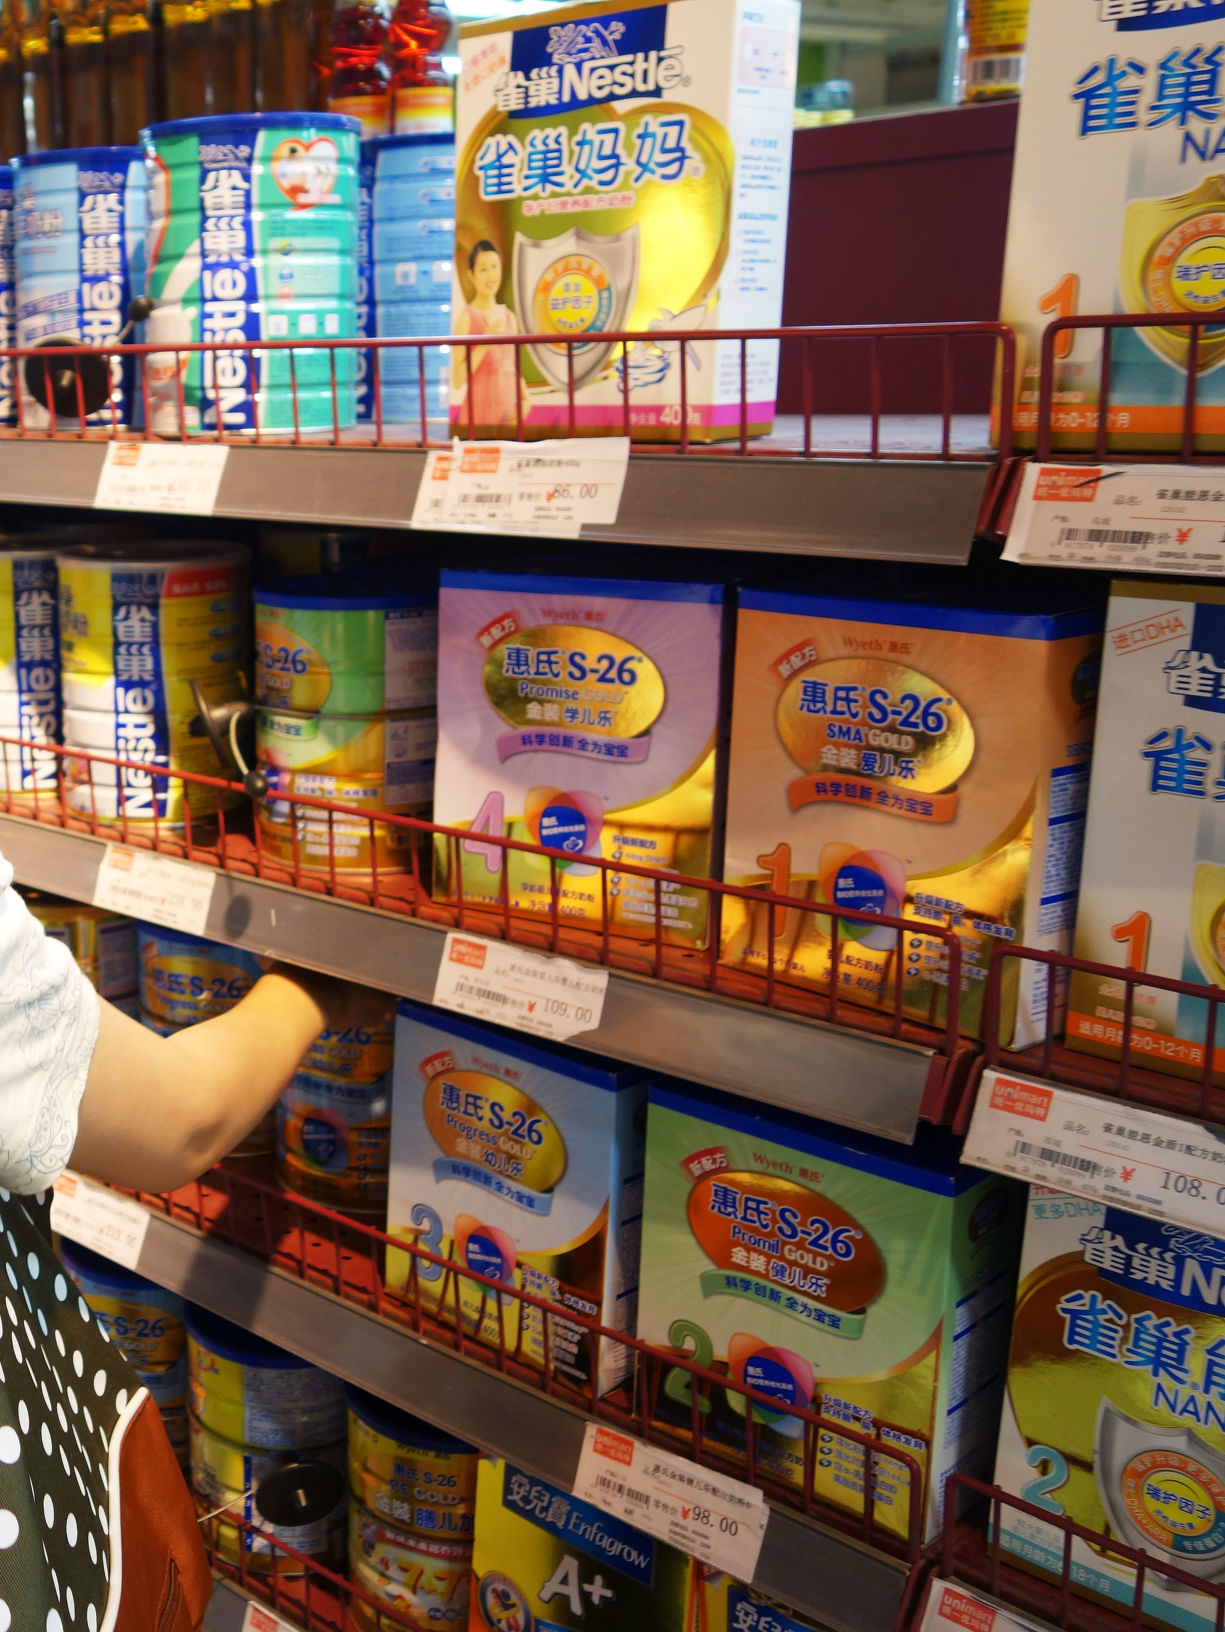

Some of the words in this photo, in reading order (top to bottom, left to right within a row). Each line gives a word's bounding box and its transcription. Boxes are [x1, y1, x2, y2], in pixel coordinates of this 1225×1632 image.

[494, 65, 561, 112] 雀巢
[1073, 45, 1225, 137] 雀巢
[477, 119, 693, 196] 雀巢妈妈
[79, 193, 123, 276] 雀巢
[200, 169, 250, 263] 雀巢
[1038, 271, 1080, 360] 1
[15, 589, 56, 661] 雀巢
[113, 604, 156, 681] 雀巢
[842, 635, 884, 651] Wyeth
[1111, 616, 1187, 650] 进口DHA
[503, 646, 561, 679] 惠氏
[568, 651, 638, 686] S-26
[519, 681, 580, 701] Promise
[564, 706, 614, 727] 学儿乐
[798, 679, 861, 720] 惠氏
[867, 688, 946, 733] S-26
[521, 733, 576, 750] 科学创新
[577, 737, 630, 759] 全为宝宝
[827, 723, 864, 744] SMA
[868, 729, 915, 751] GOLD
[861, 751, 917, 780] 爱儿乐
[1142, 727, 1225, 802] 雀
[815, 782, 873, 800] 科学创新
[876, 790, 934, 816] 全为宝宝
[464, 790, 504, 873] 4
[756, 842, 792, 938] 1
[1112, 911, 1151, 986] 1
[319, 1026, 373, 1046] -26
[440, 1082, 484, 1122] 惠氏
[489, 1101, 543, 1146] S-26
[994, 1083, 1049, 1107] unimart
[446, 1113, 498, 1146] Progress
[498, 1135, 533, 1160] GOLD
[484, 1149, 524, 1178] 幼儿乐
[688, 1152, 728, 1178] 新配方
[753, 1152, 794, 1175] Wyeth
[410, 1202, 443, 1281] 3
[710, 1182, 772, 1230] 惠氏
[777, 1206, 855, 1260] S-26
[730, 1246, 769, 1275] 金装
[770, 1260, 828, 1298] 健儿乐
[731, 1225, 781, 1255] Promil
[783, 1244, 830, 1272] GOLD
[1079, 1226, 1177, 1292] 雀巢
[114, 1316, 166, 1339] S-26
[724, 1275, 782, 1304] 科学创新
[784, 1295, 842, 1330] 全为宝宝
[663, 1318, 714, 1414] 2
[1154, 1381, 1225, 1432] NAN
[413, 1487, 460, 1505] GOLD
[423, 1471, 457, 1488] S-26
[1022, 1444, 1069, 1516] 2
[568, 1511, 651, 1569] Enfagrow
[537, 1553, 615, 1619] A+
[943, 1594, 995, 1625] unimart
